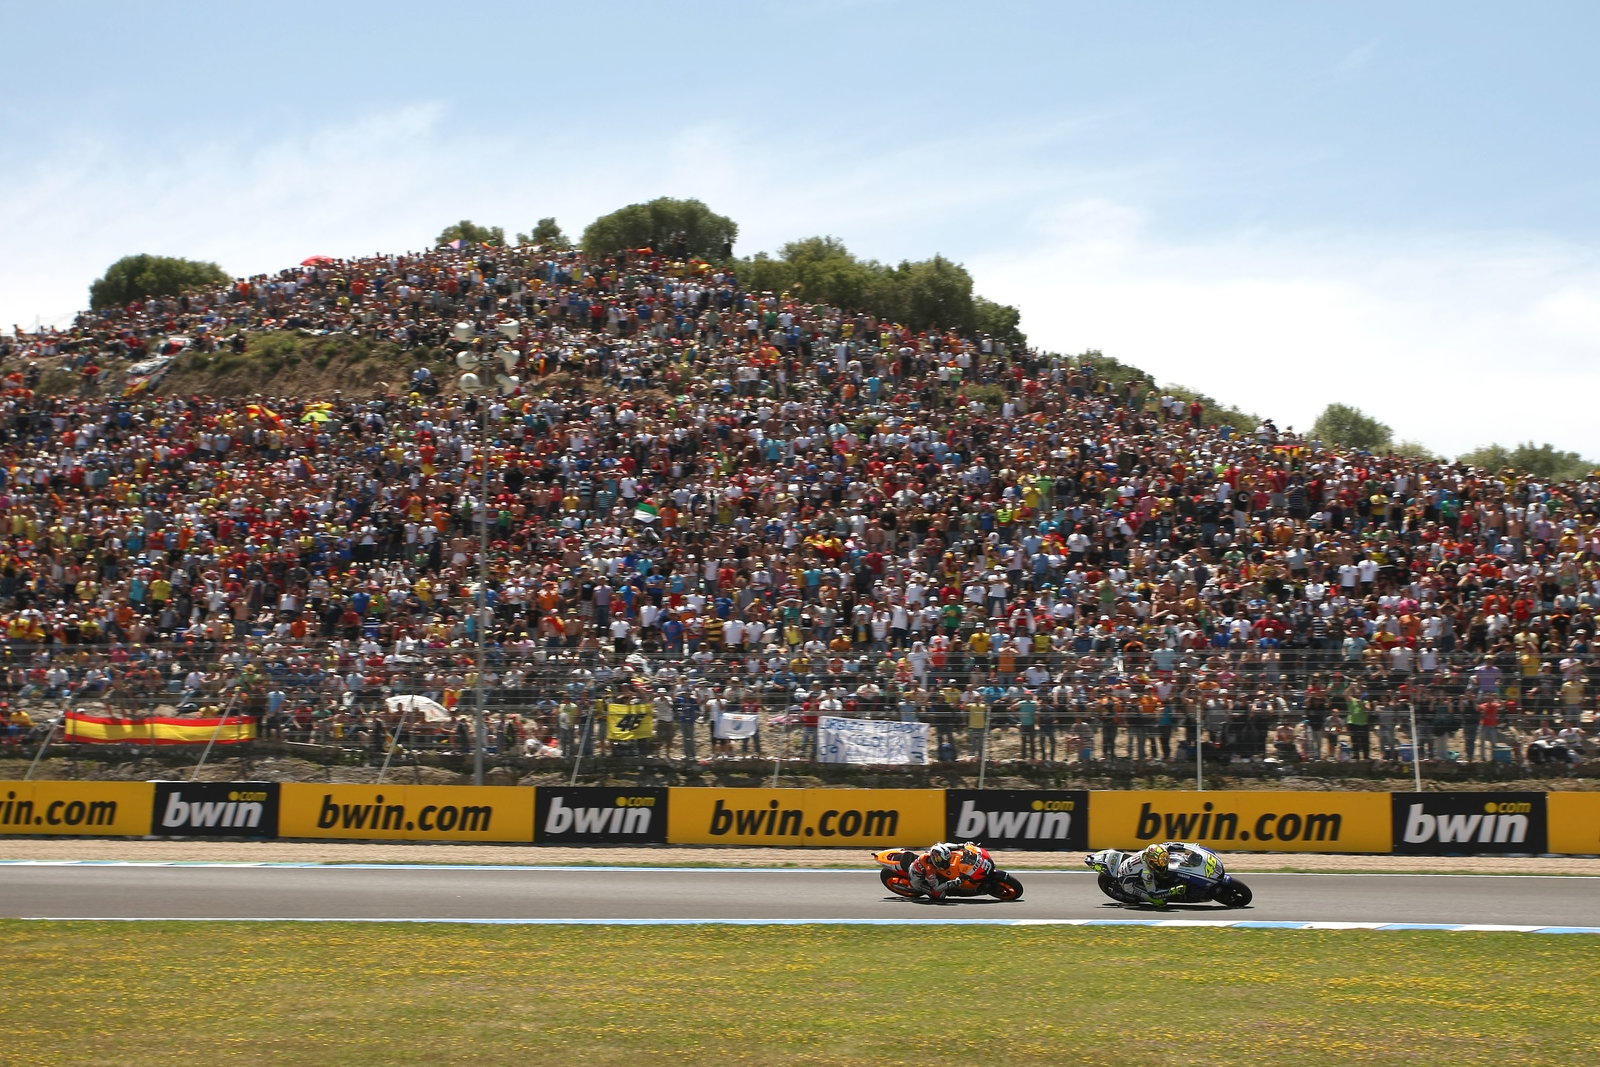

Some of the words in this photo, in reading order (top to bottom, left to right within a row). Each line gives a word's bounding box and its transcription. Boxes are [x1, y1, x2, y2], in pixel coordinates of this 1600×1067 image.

[0, 791, 117, 825] in.com
[163, 792, 263, 827] bwin
[317, 794, 492, 832] bwin.com
[545, 796, 652, 834] bwin
[709, 799, 898, 837] bwin.com
[955, 800, 1072, 839] bwin
[1135, 801, 1341, 841] bwin.com
[1404, 803, 1528, 843] bwin
[1205, 853, 1217, 878] 46
